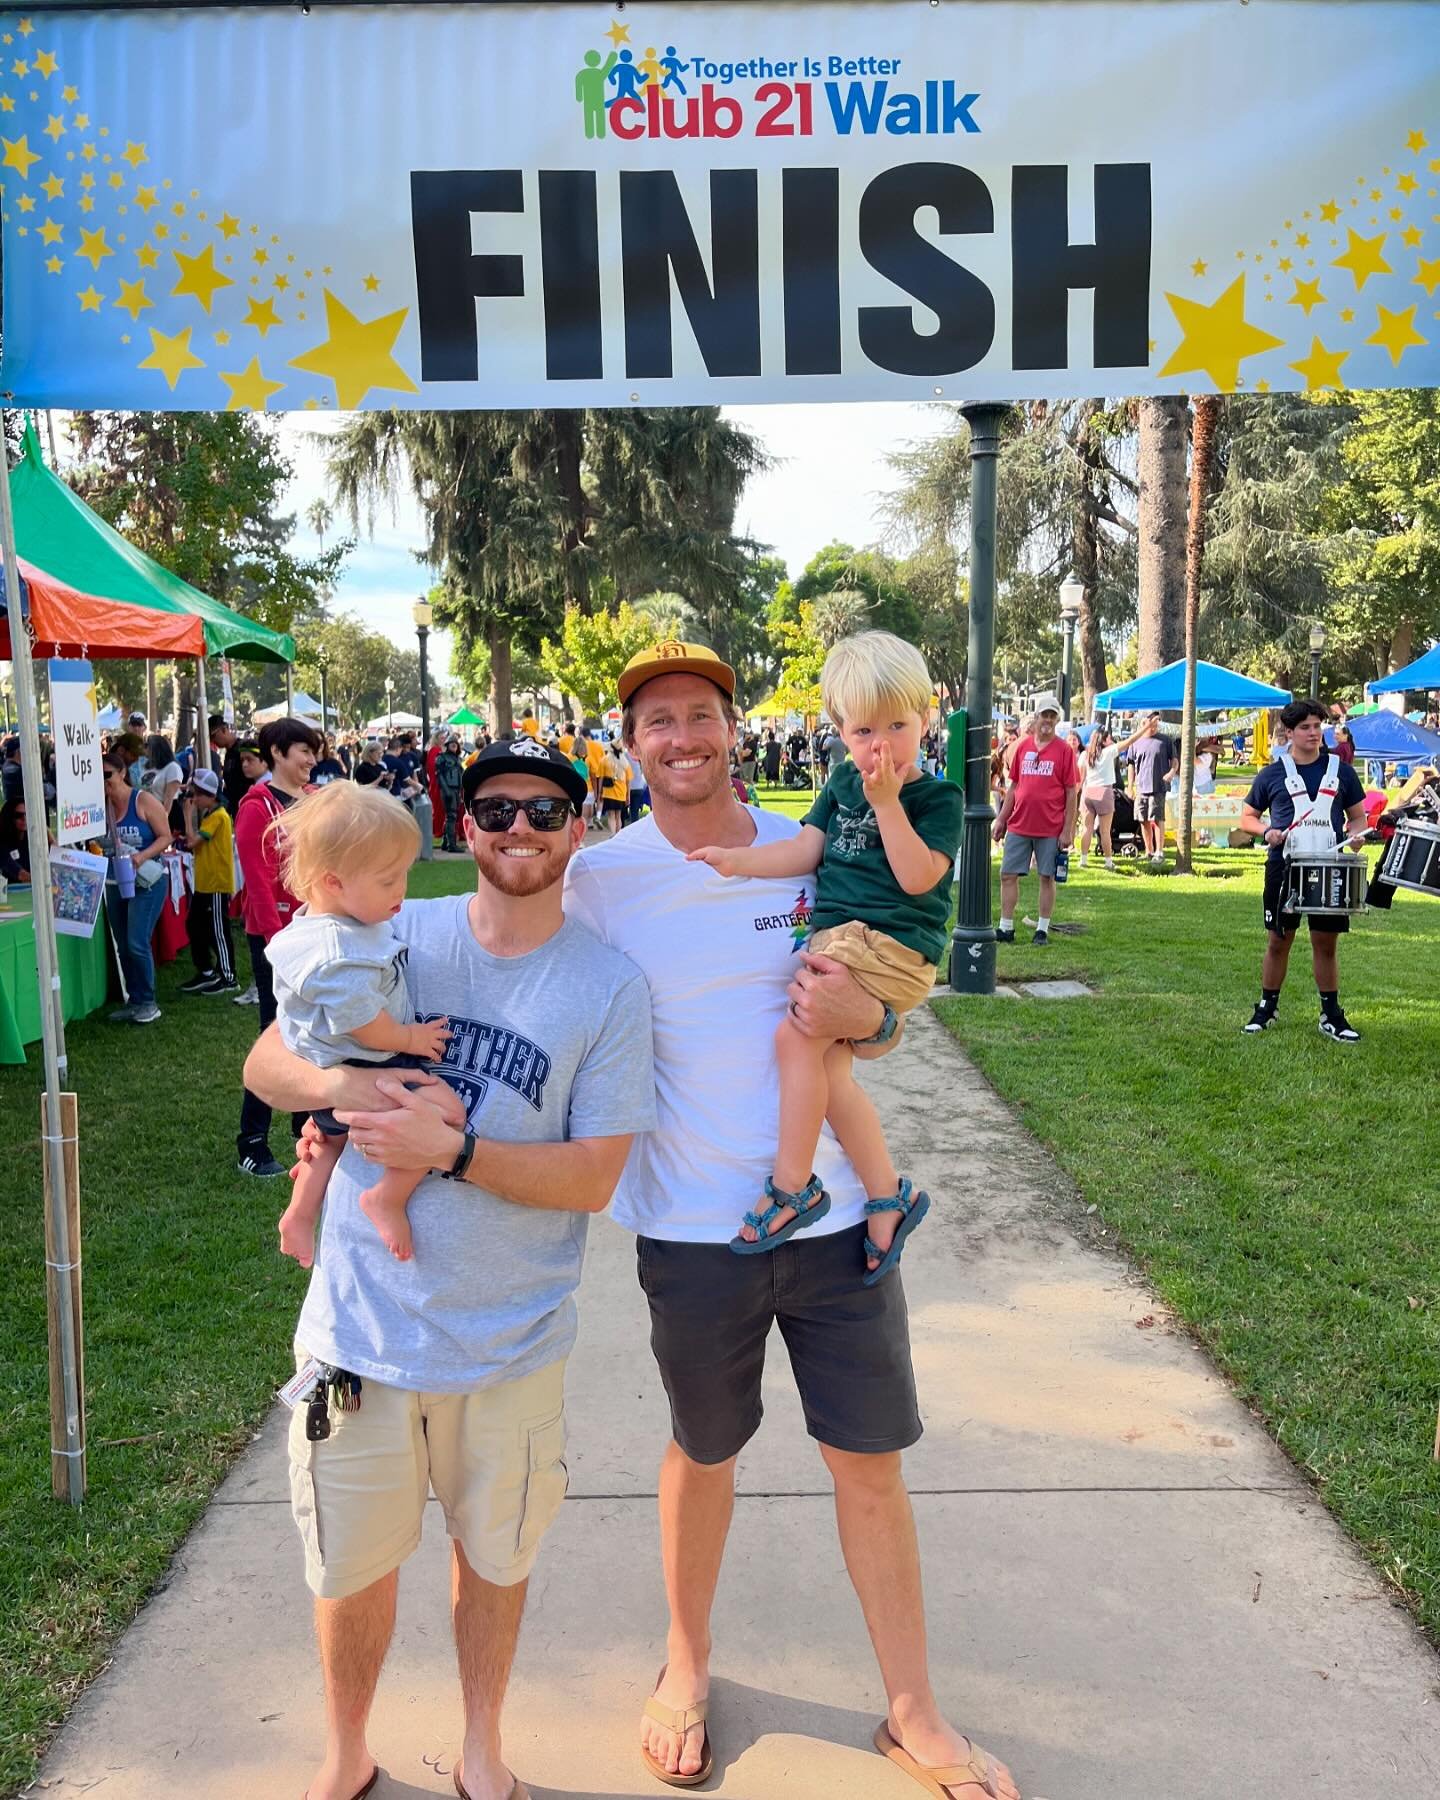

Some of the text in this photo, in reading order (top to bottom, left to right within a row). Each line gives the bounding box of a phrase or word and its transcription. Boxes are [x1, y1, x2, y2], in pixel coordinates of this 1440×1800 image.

[690, 55, 901, 84] Together Is Better
[609, 79, 982, 140] club 21 Walk
[410, 162, 1152, 382] FINISH
[71, 755, 92, 782] Ups
[81, 809, 89, 826] 21
[1303, 819, 1331, 827] YAMAHA
[754, 912, 812, 931] GRATEFU
